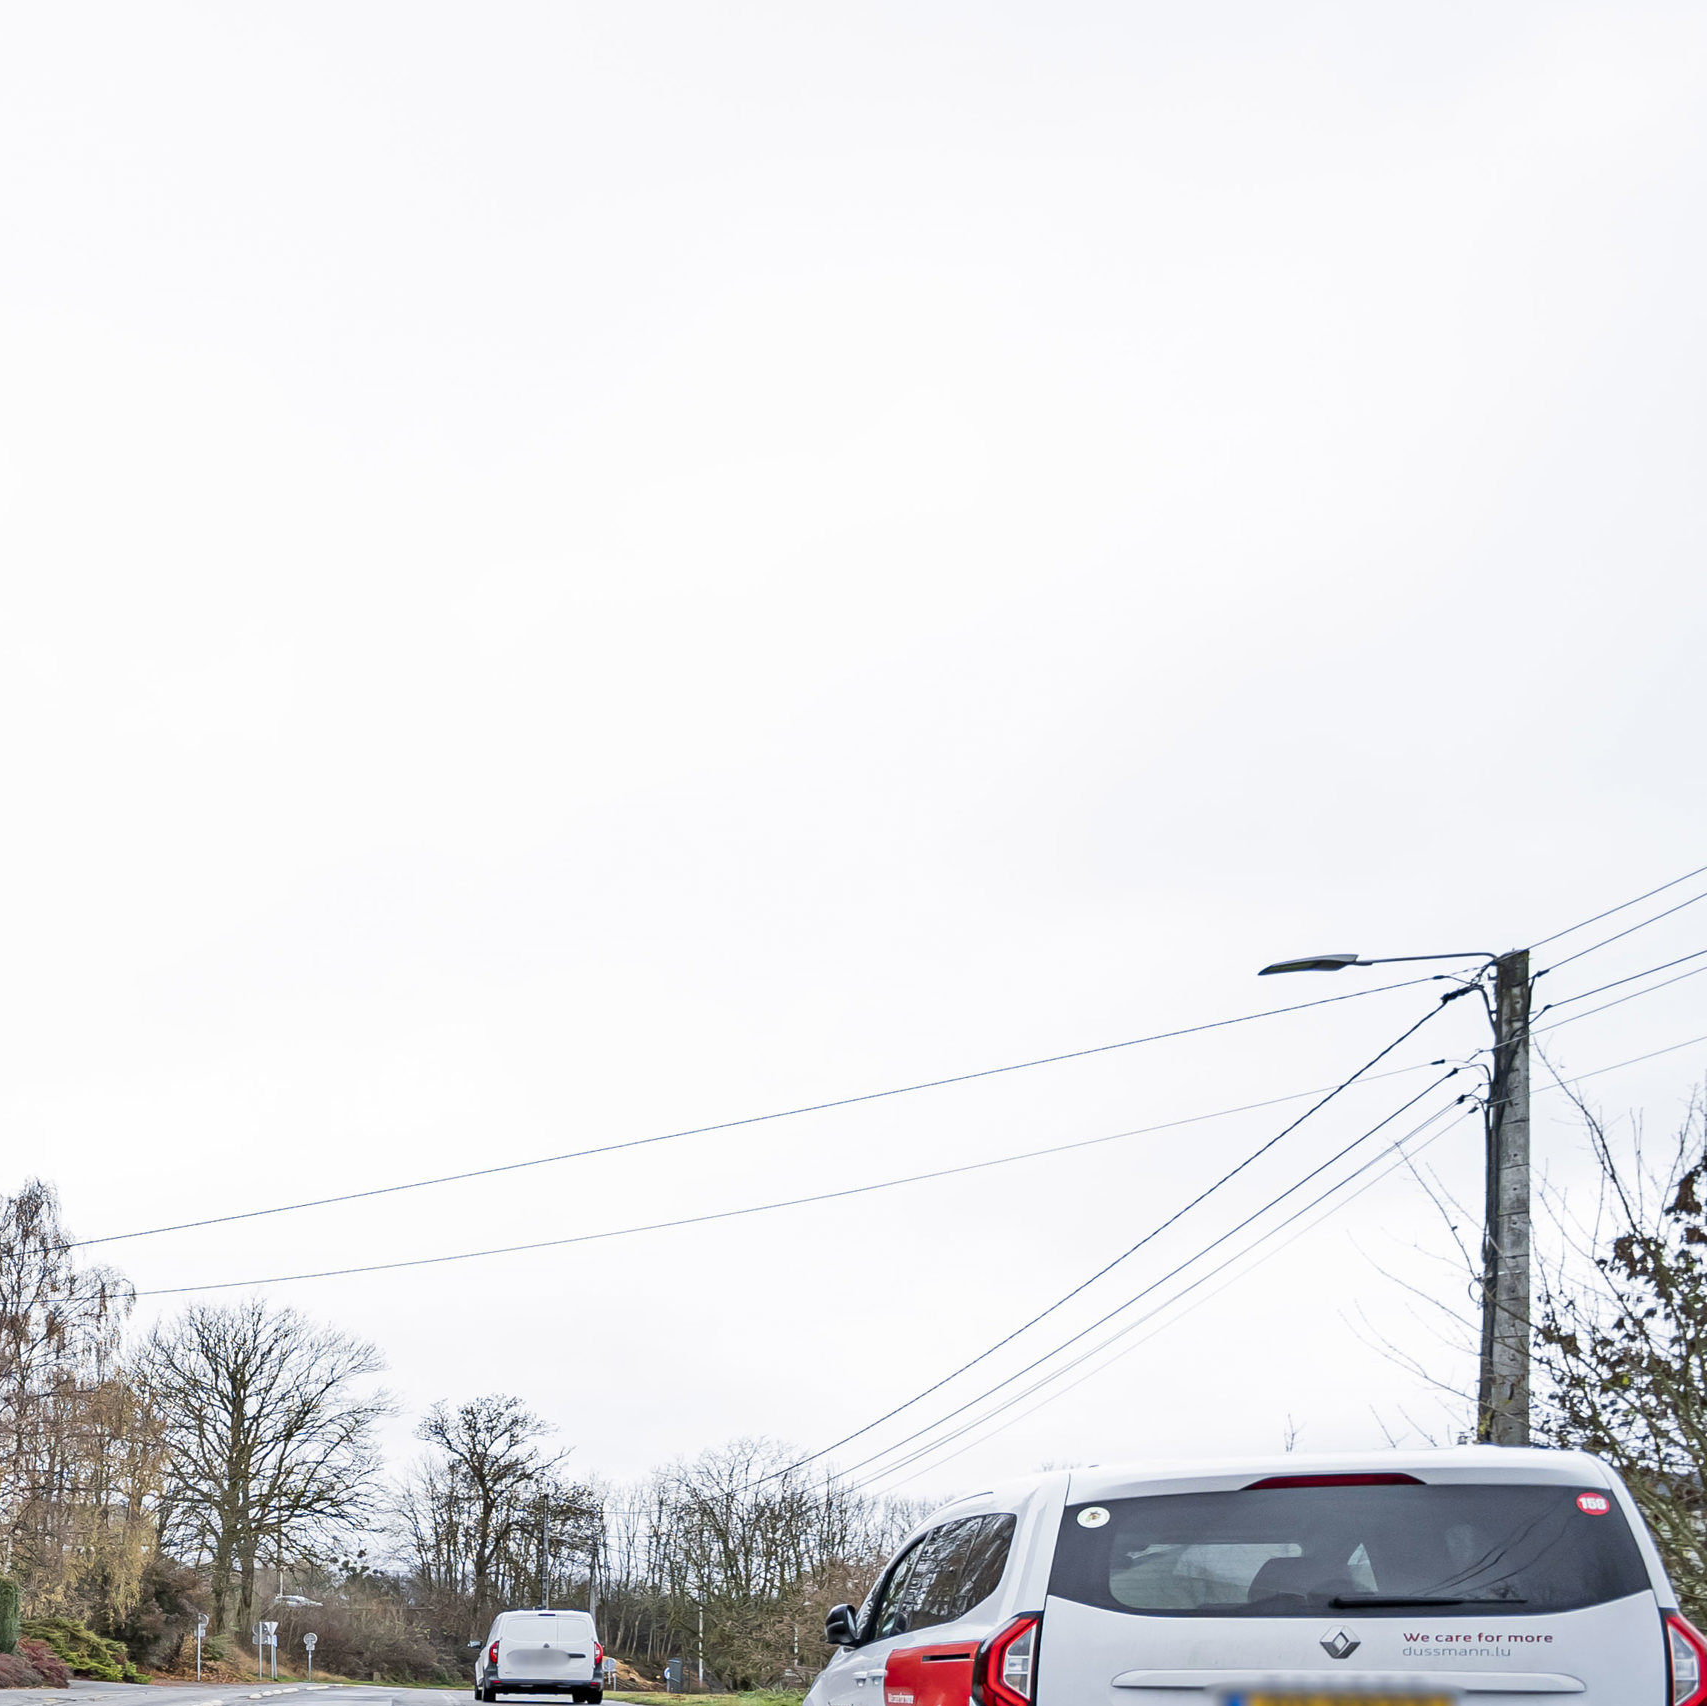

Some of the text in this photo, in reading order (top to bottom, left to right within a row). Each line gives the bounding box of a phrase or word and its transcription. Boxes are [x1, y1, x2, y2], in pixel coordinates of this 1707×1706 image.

[1403, 1632, 1553, 1643] We care for more
[1402, 1646, 1512, 1657] dussmann.lu
